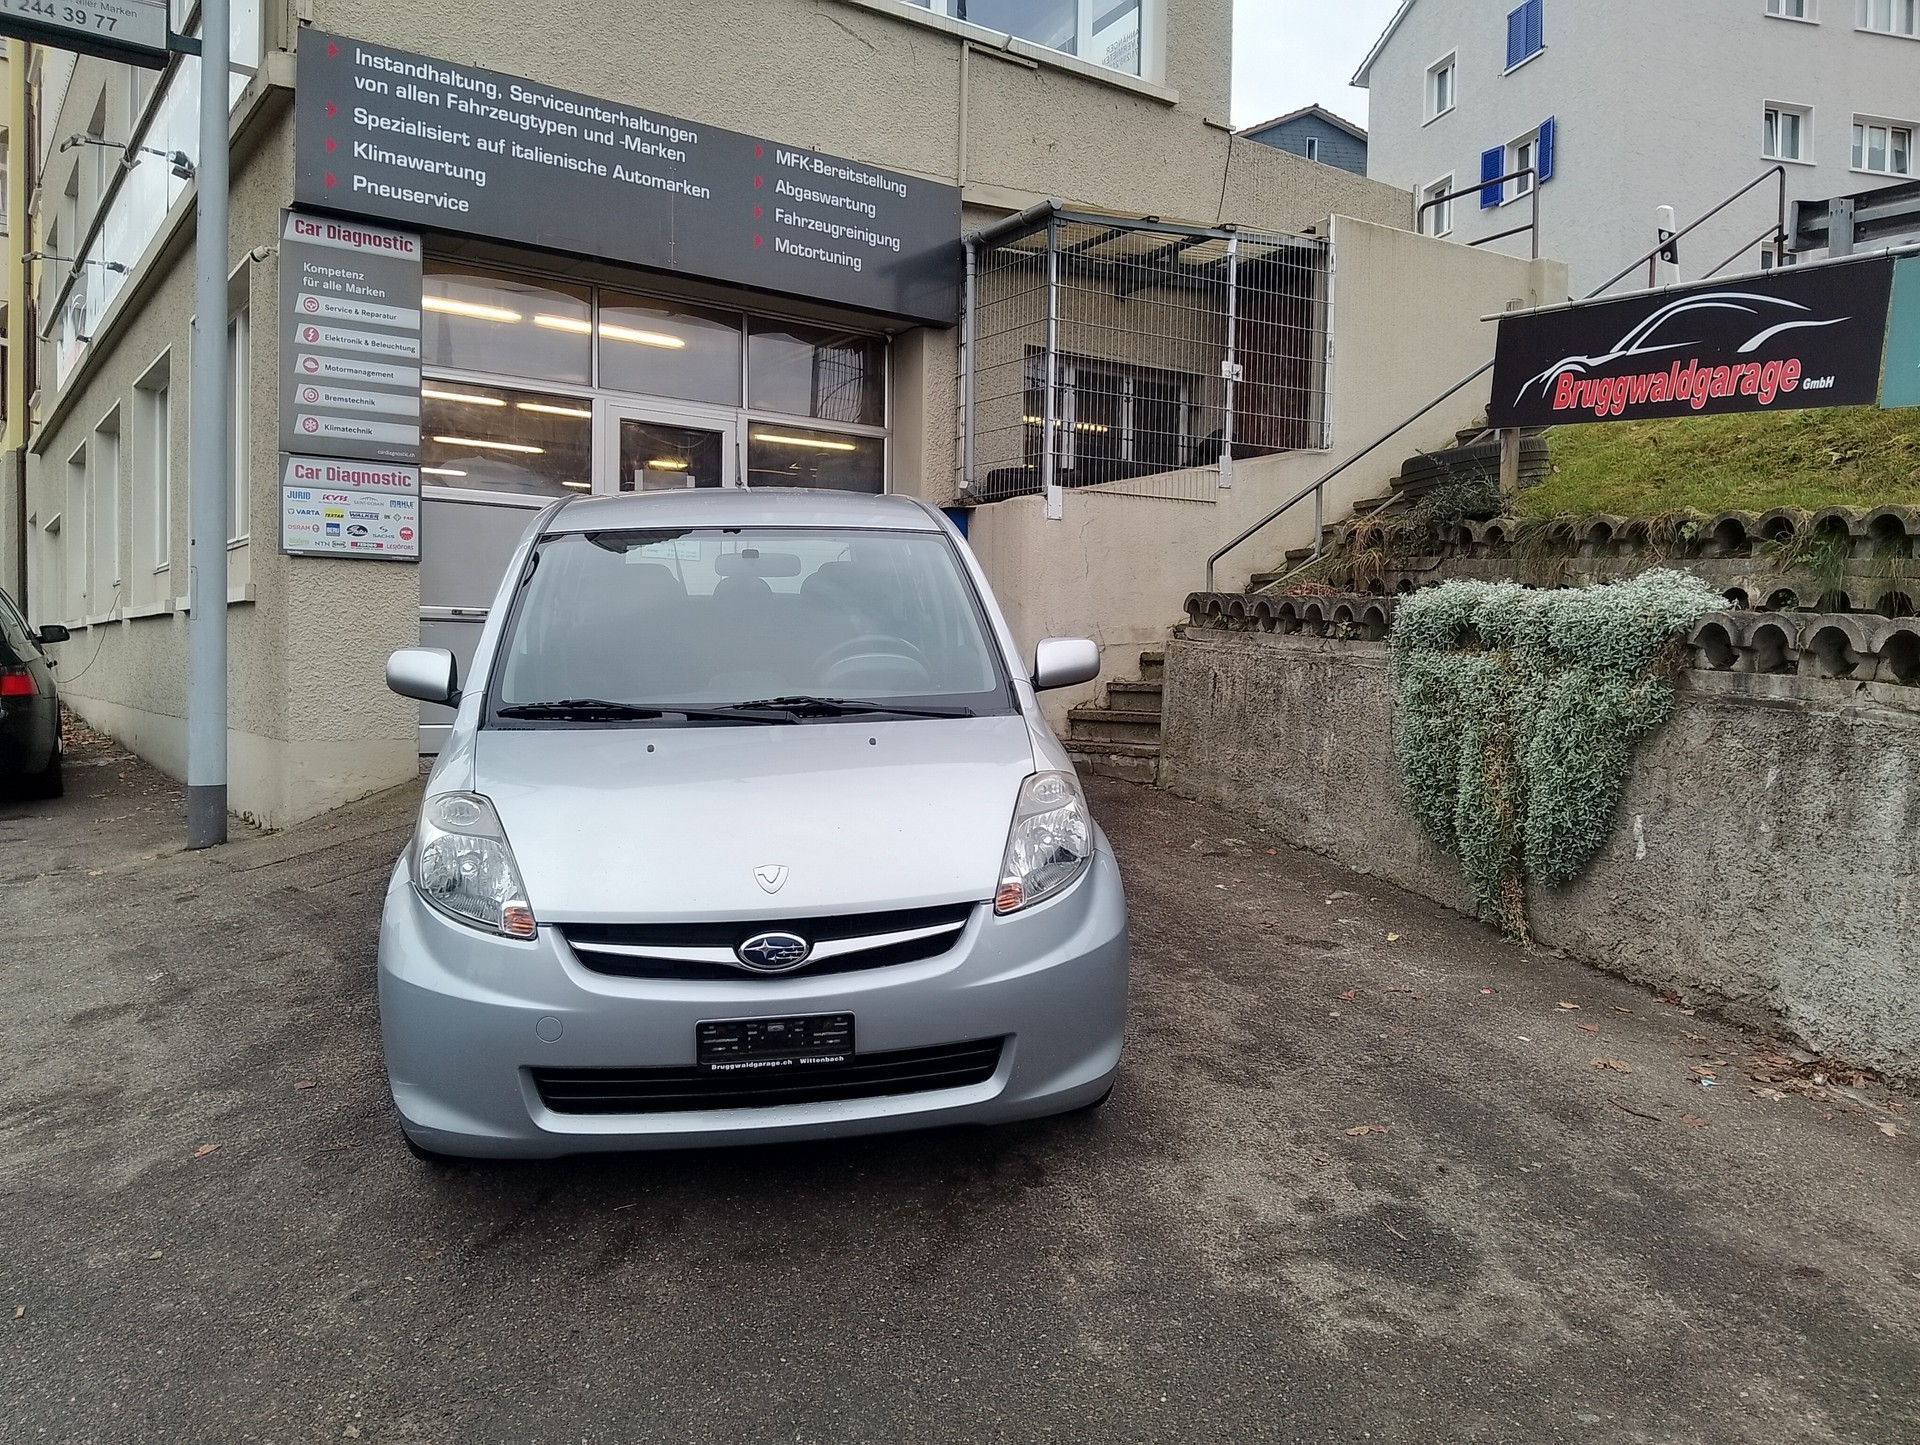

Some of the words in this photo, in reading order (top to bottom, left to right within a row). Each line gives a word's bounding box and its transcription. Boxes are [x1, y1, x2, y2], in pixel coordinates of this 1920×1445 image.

[19, 0, 56, 18] 244
[63, 7, 87, 25] 39
[94, 13, 118, 32] 77
[100, 2, 138, 18] Marken
[355, 48, 502, 100] Instandhaltung,
[510, 85, 698, 144] Serviceunterhaltungen
[354, 76, 388, 95] von
[395, 84, 439, 106] allen
[447, 93, 578, 137] Fahrzeugtypen
[584, 128, 614, 147] und
[619, 134, 686, 163] -Marken
[353, 107, 471, 147] Spezialisiert
[476, 137, 506, 155] auf
[511, 142, 607, 177] italienische
[612, 164, 710, 200] Automarken
[353, 140, 487, 187] Klimawartung
[776, 149, 907, 198] MFK-Bereitstellung
[353, 174, 470, 213] Pneuservice
[775, 179, 876, 218] Abgaswartung
[294, 219, 322, 238] Car
[326, 224, 414, 253] Diagnostic
[775, 207, 901, 252] Fahrzeugreinigung
[775, 237, 862, 272] Motortuning
[303, 261, 365, 281] Kompetenz
[302, 276, 319, 288] für
[322, 281, 342, 292] alle
[345, 283, 386, 299] Marken
[324, 304, 353, 315] Service
[361, 310, 398, 321] Reparatur
[324, 334, 363, 346] Elektronik
[364, 339, 370, 347] &
[371, 340, 416, 354] Beleuchtung
[324, 364, 394, 379] Motormanagement
[324, 393, 376, 406] Bremstechnik
[1552, 358, 1802, 417] Bruggwaldgarage
[1803, 375, 1835, 391] GmbH
[324, 424, 373, 435] Klimatechnik
[294, 464, 322, 480] Car
[326, 466, 412, 488] Diagnostic
[287, 490, 311, 500] JURID
[389, 500, 416, 510] MAHLE
[349, 511, 380, 520] WALKER
[711, 1060, 793, 1071] Bruggwaldgarage.ch
